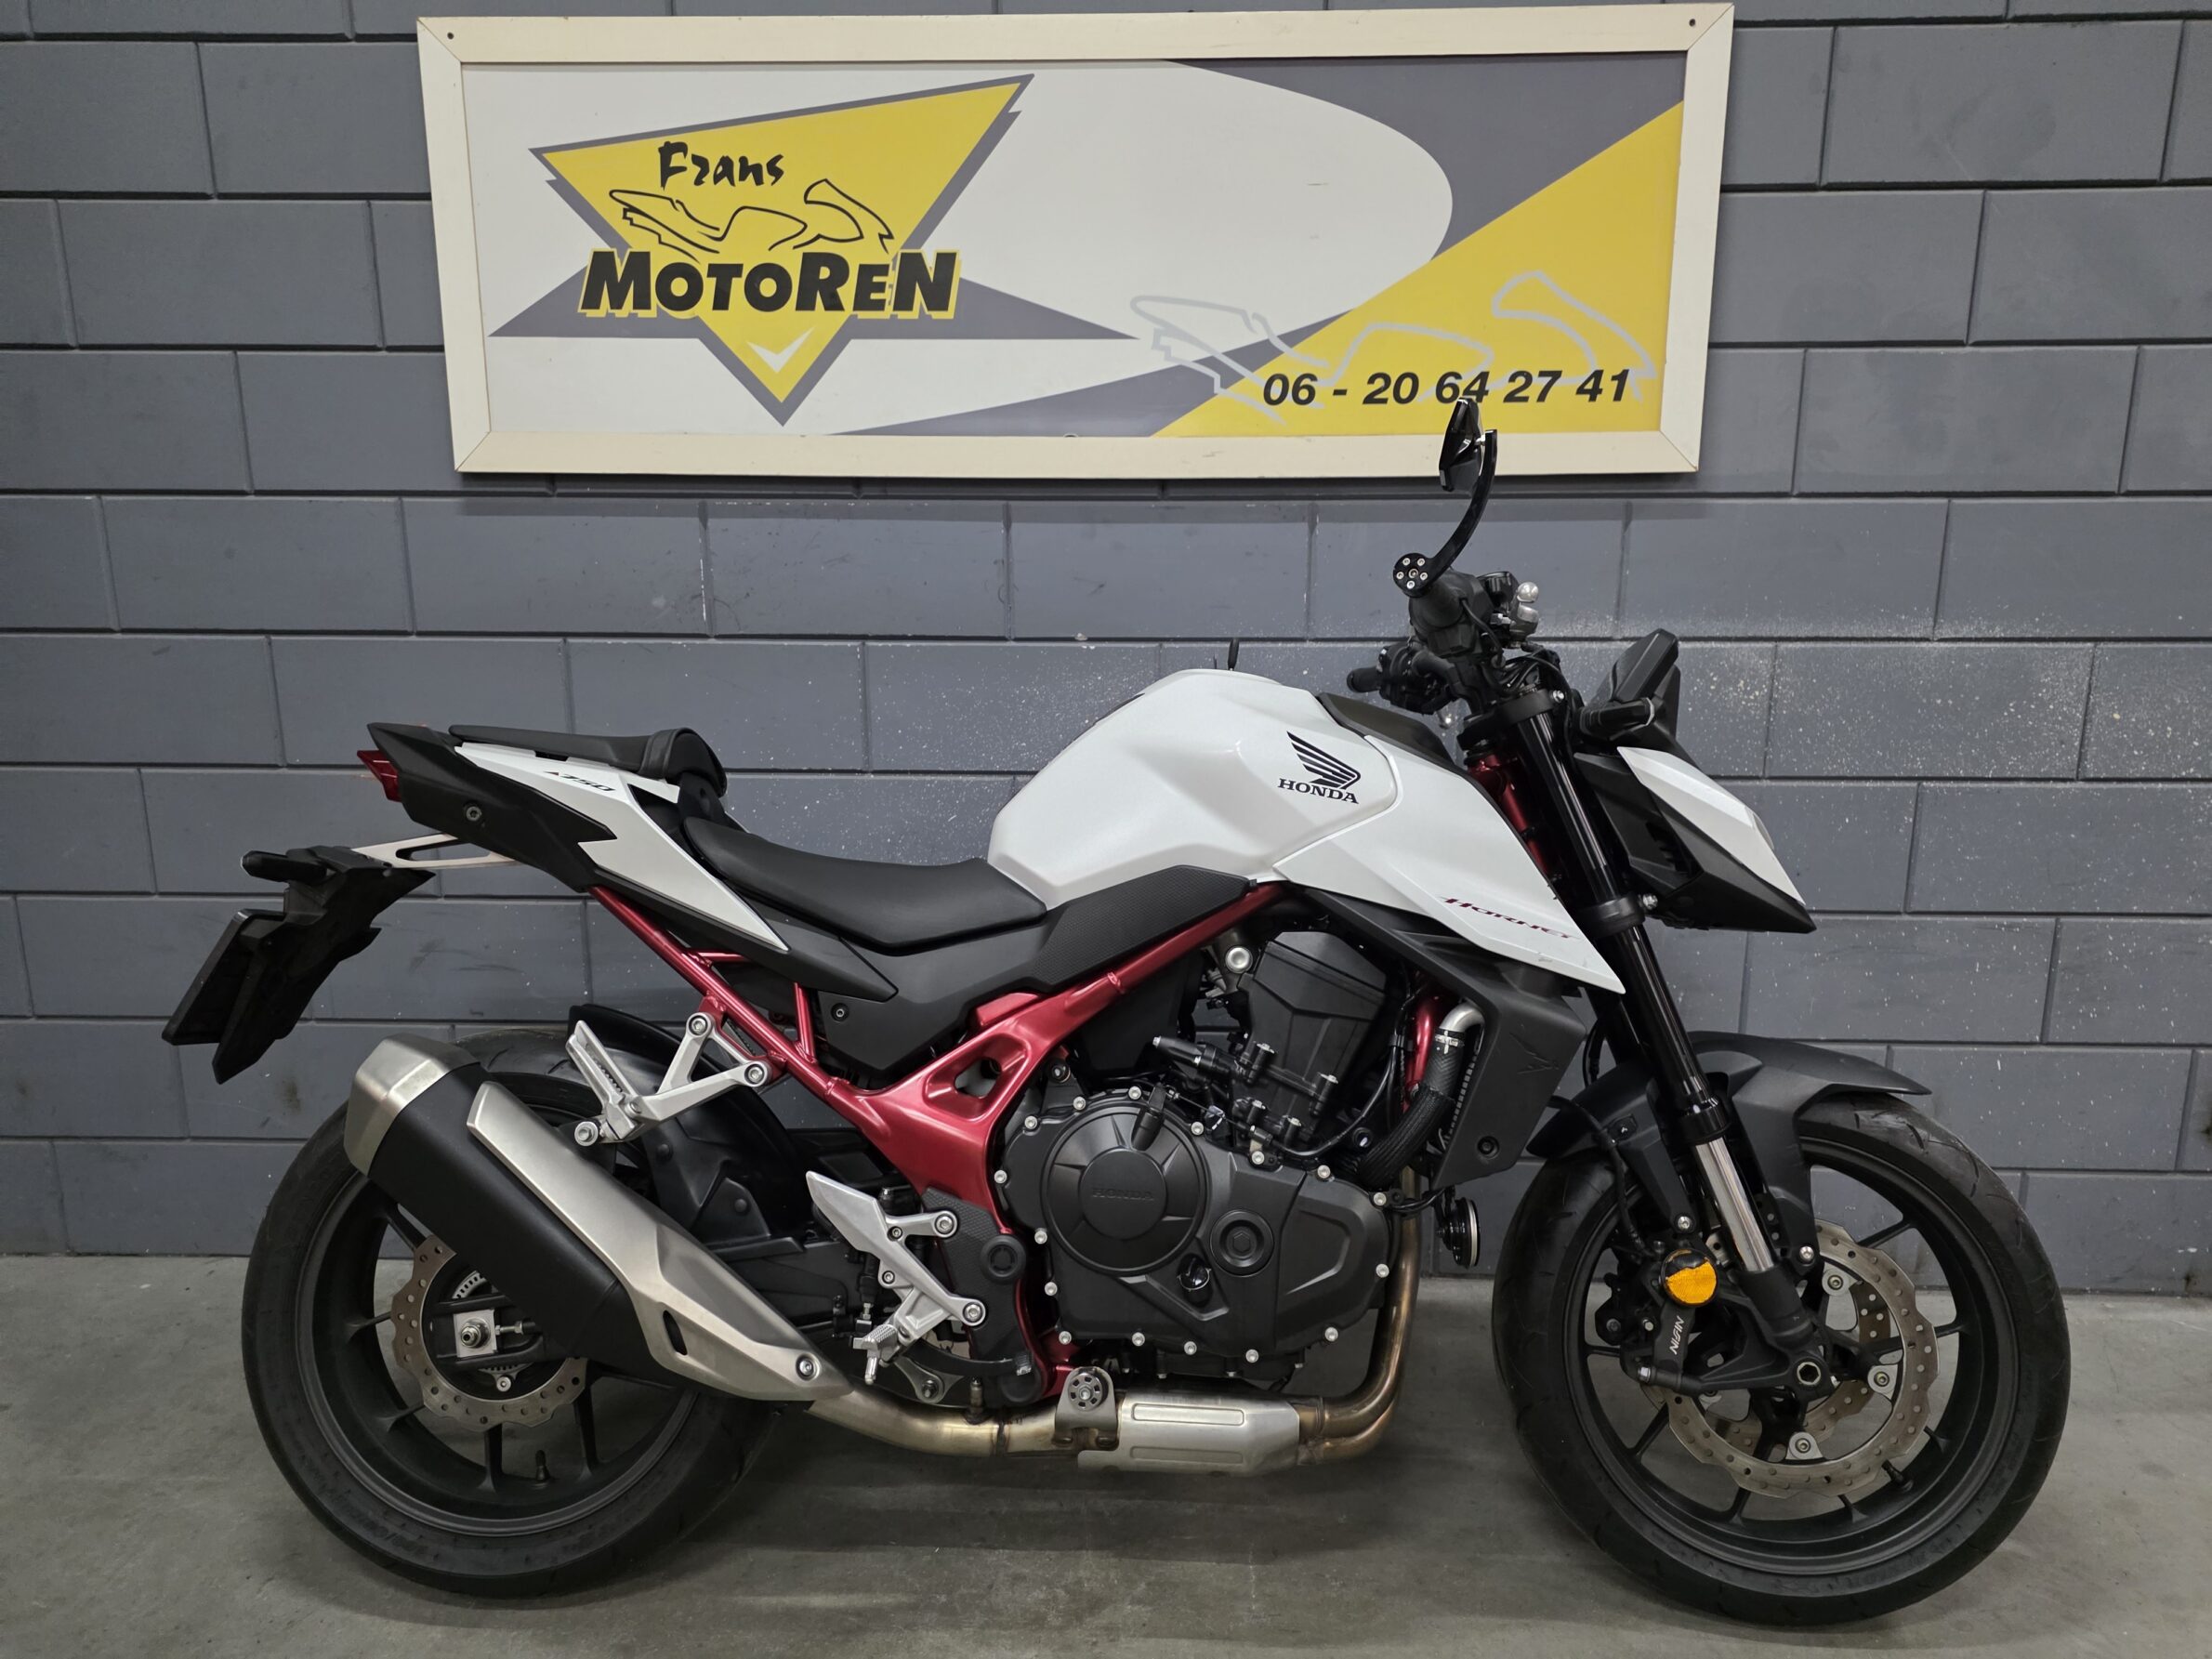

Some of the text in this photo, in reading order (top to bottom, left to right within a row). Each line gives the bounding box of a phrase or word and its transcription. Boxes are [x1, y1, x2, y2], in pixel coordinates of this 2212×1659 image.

[658, 140, 784, 190] Frans
[1263, 373, 1318, 406] 06
[1363, 372, 1419, 405] 20
[1435, 371, 1490, 404] 64
[1503, 370, 1562, 403] 27
[1575, 369, 1629, 402] 41
[560, 773, 616, 792] 750
[1278, 778, 1360, 805] HONDA
[1092, 1188, 1154, 1202] HONDA
[1669, 1315, 1684, 1355] NISSIN
